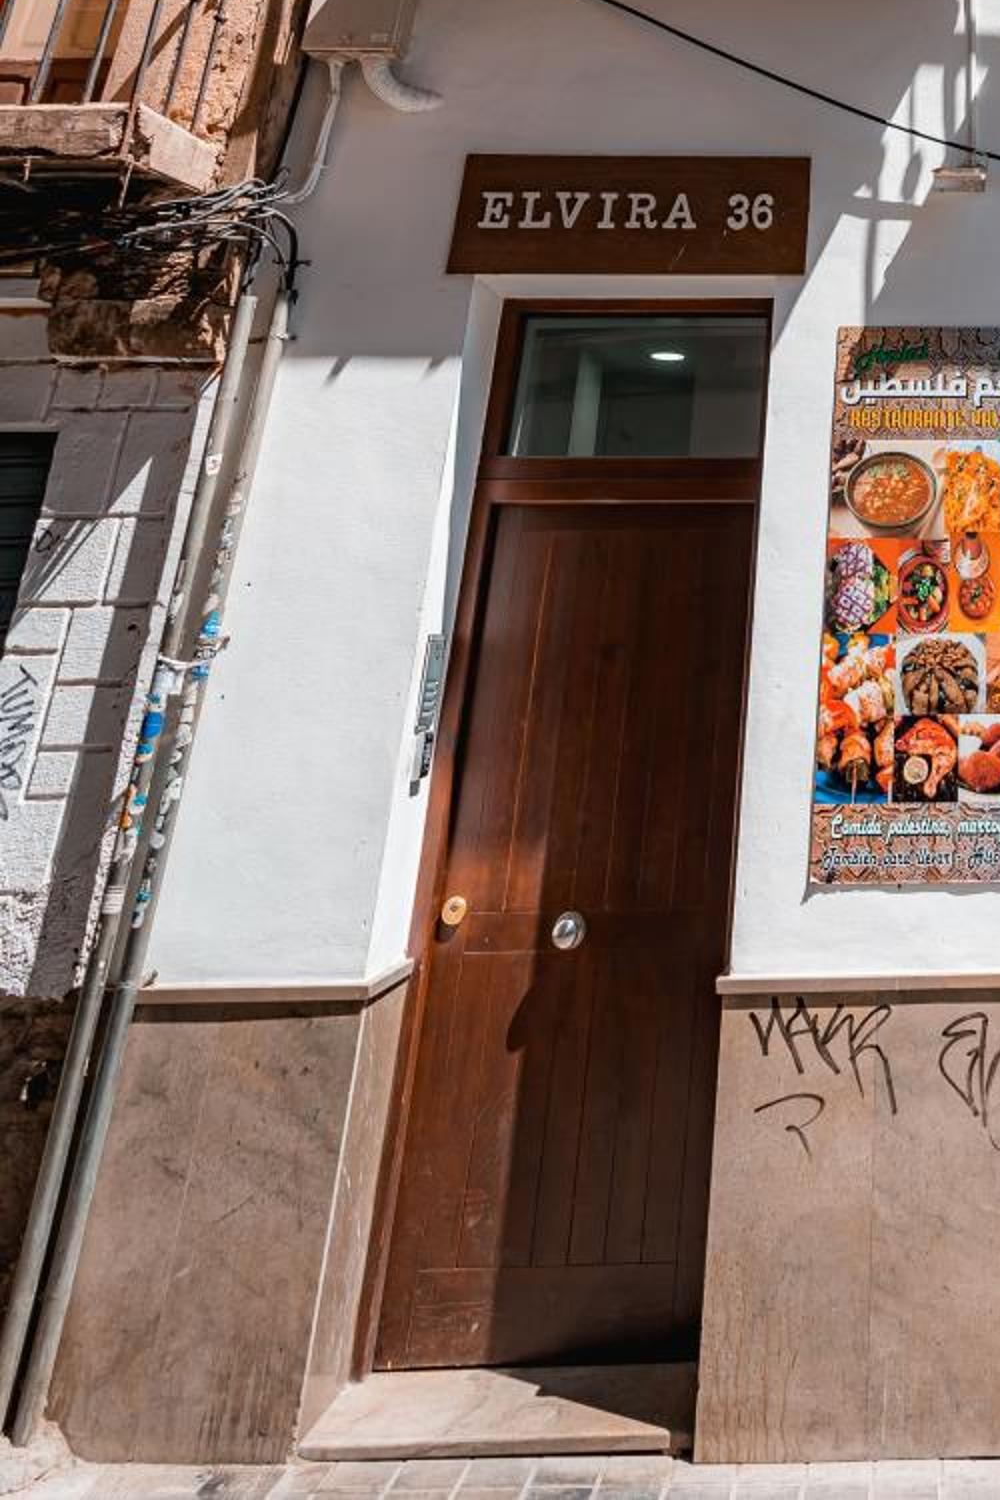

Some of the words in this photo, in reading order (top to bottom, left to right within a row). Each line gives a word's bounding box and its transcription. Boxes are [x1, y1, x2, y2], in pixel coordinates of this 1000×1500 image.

[477, 191, 697, 229] ELVIRA
[726, 193, 775, 231] 36
[841, 369, 967, 405] فلسطين
[850, 408, 963, 428] RESTAURANTE
[831, 813, 881, 839] Comida
